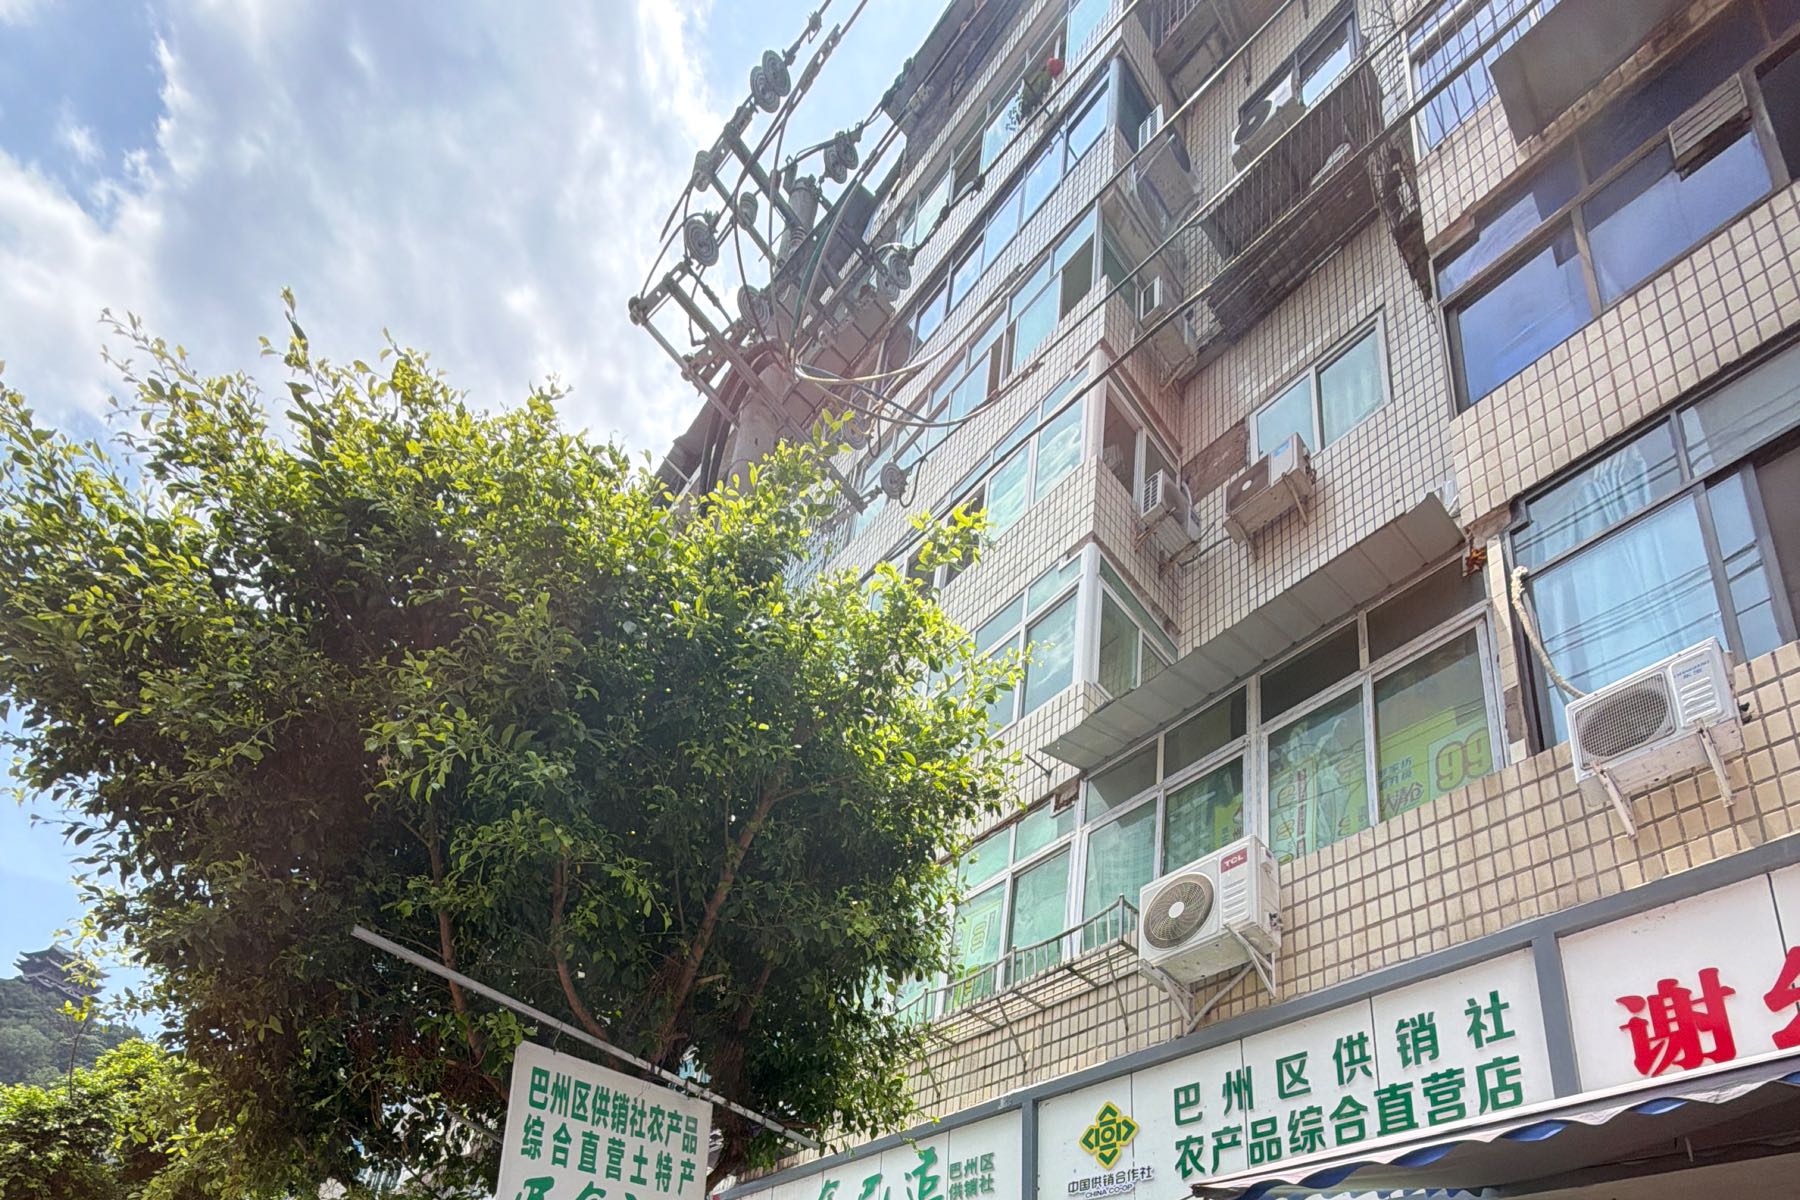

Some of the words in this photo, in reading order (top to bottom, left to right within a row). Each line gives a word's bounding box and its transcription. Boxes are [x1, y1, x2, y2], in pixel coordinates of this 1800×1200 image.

[1224, 855, 1244, 867] TCL
[1173, 990, 1516, 1126] 巴州区供销社
[528, 1066, 698, 1155] 巴州区供销社农产品
[1174, 1055, 1525, 1180] 农产品综合直营店
[520, 1114, 696, 1195] 综合直营土特产
[949, 1152, 995, 1180] 巴州区
[1067, 1166, 1153, 1193] 中国供销合作社
[1085, 1187, 1108, 1198] CHINA
[1109, 1183, 1132, 1194] CO-OP
